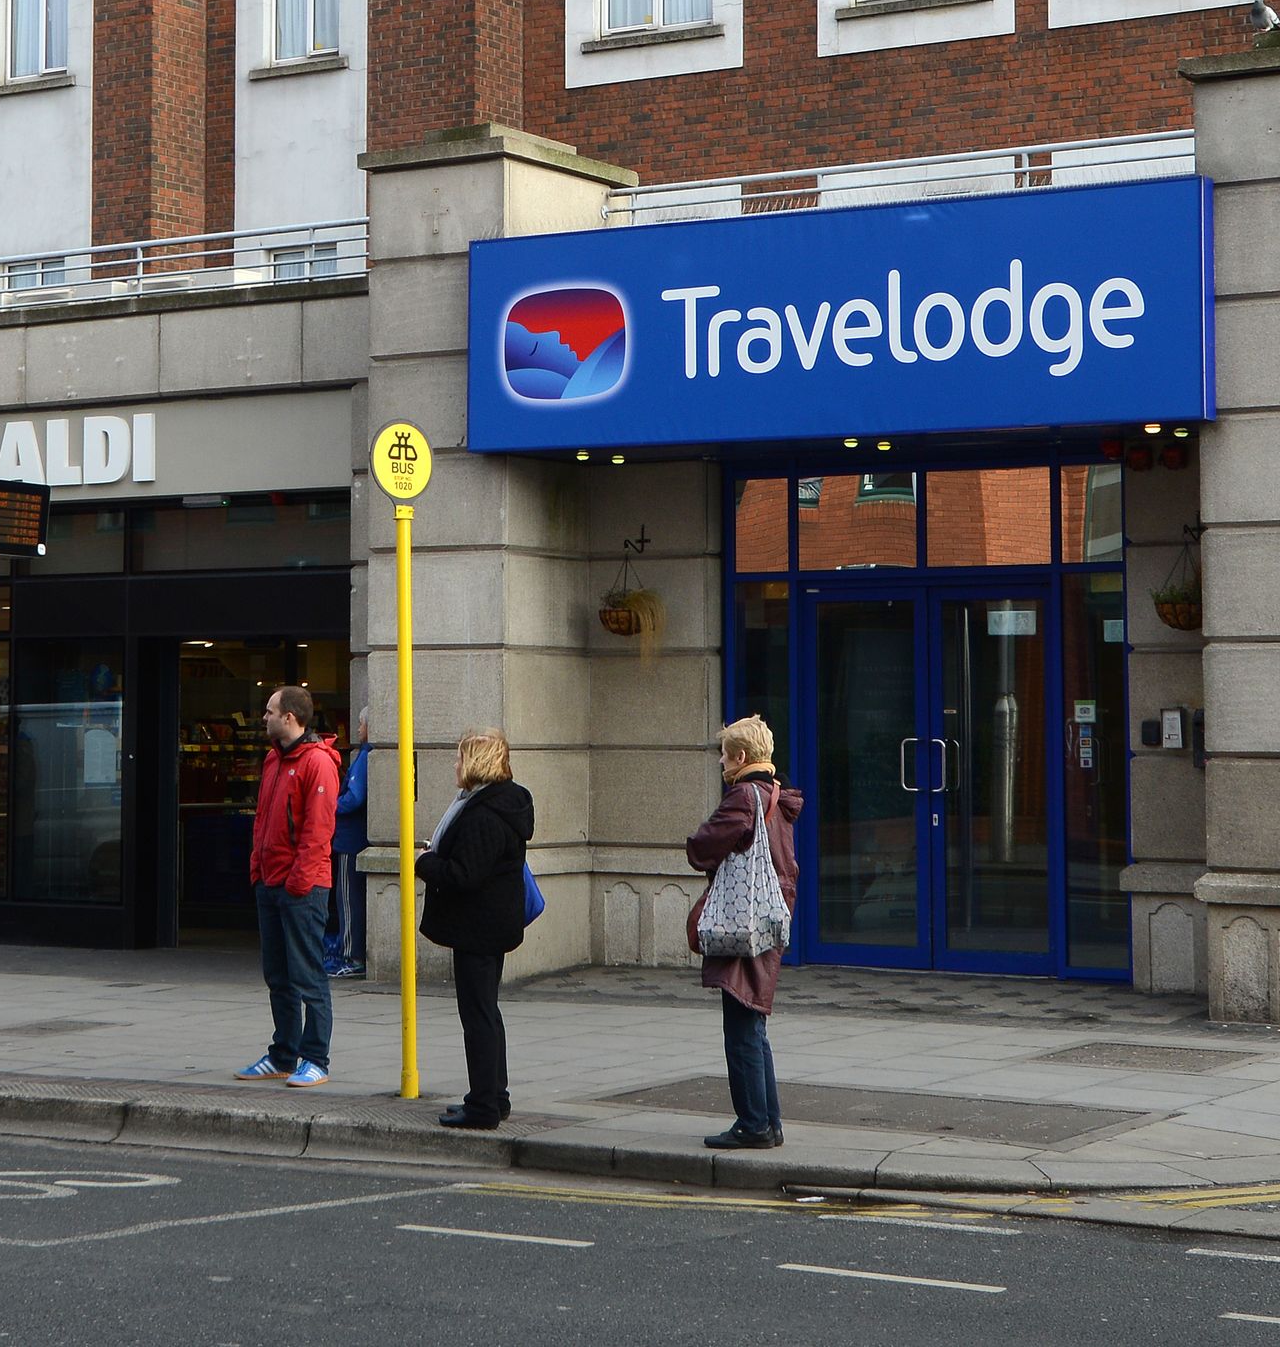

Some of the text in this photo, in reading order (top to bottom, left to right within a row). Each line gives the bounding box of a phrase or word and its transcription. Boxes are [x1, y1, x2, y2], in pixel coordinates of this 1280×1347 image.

[661, 259, 1145, 379] Travelodge
[391, 462, 414, 474] BUS
[394, 481, 413, 491] 1020
